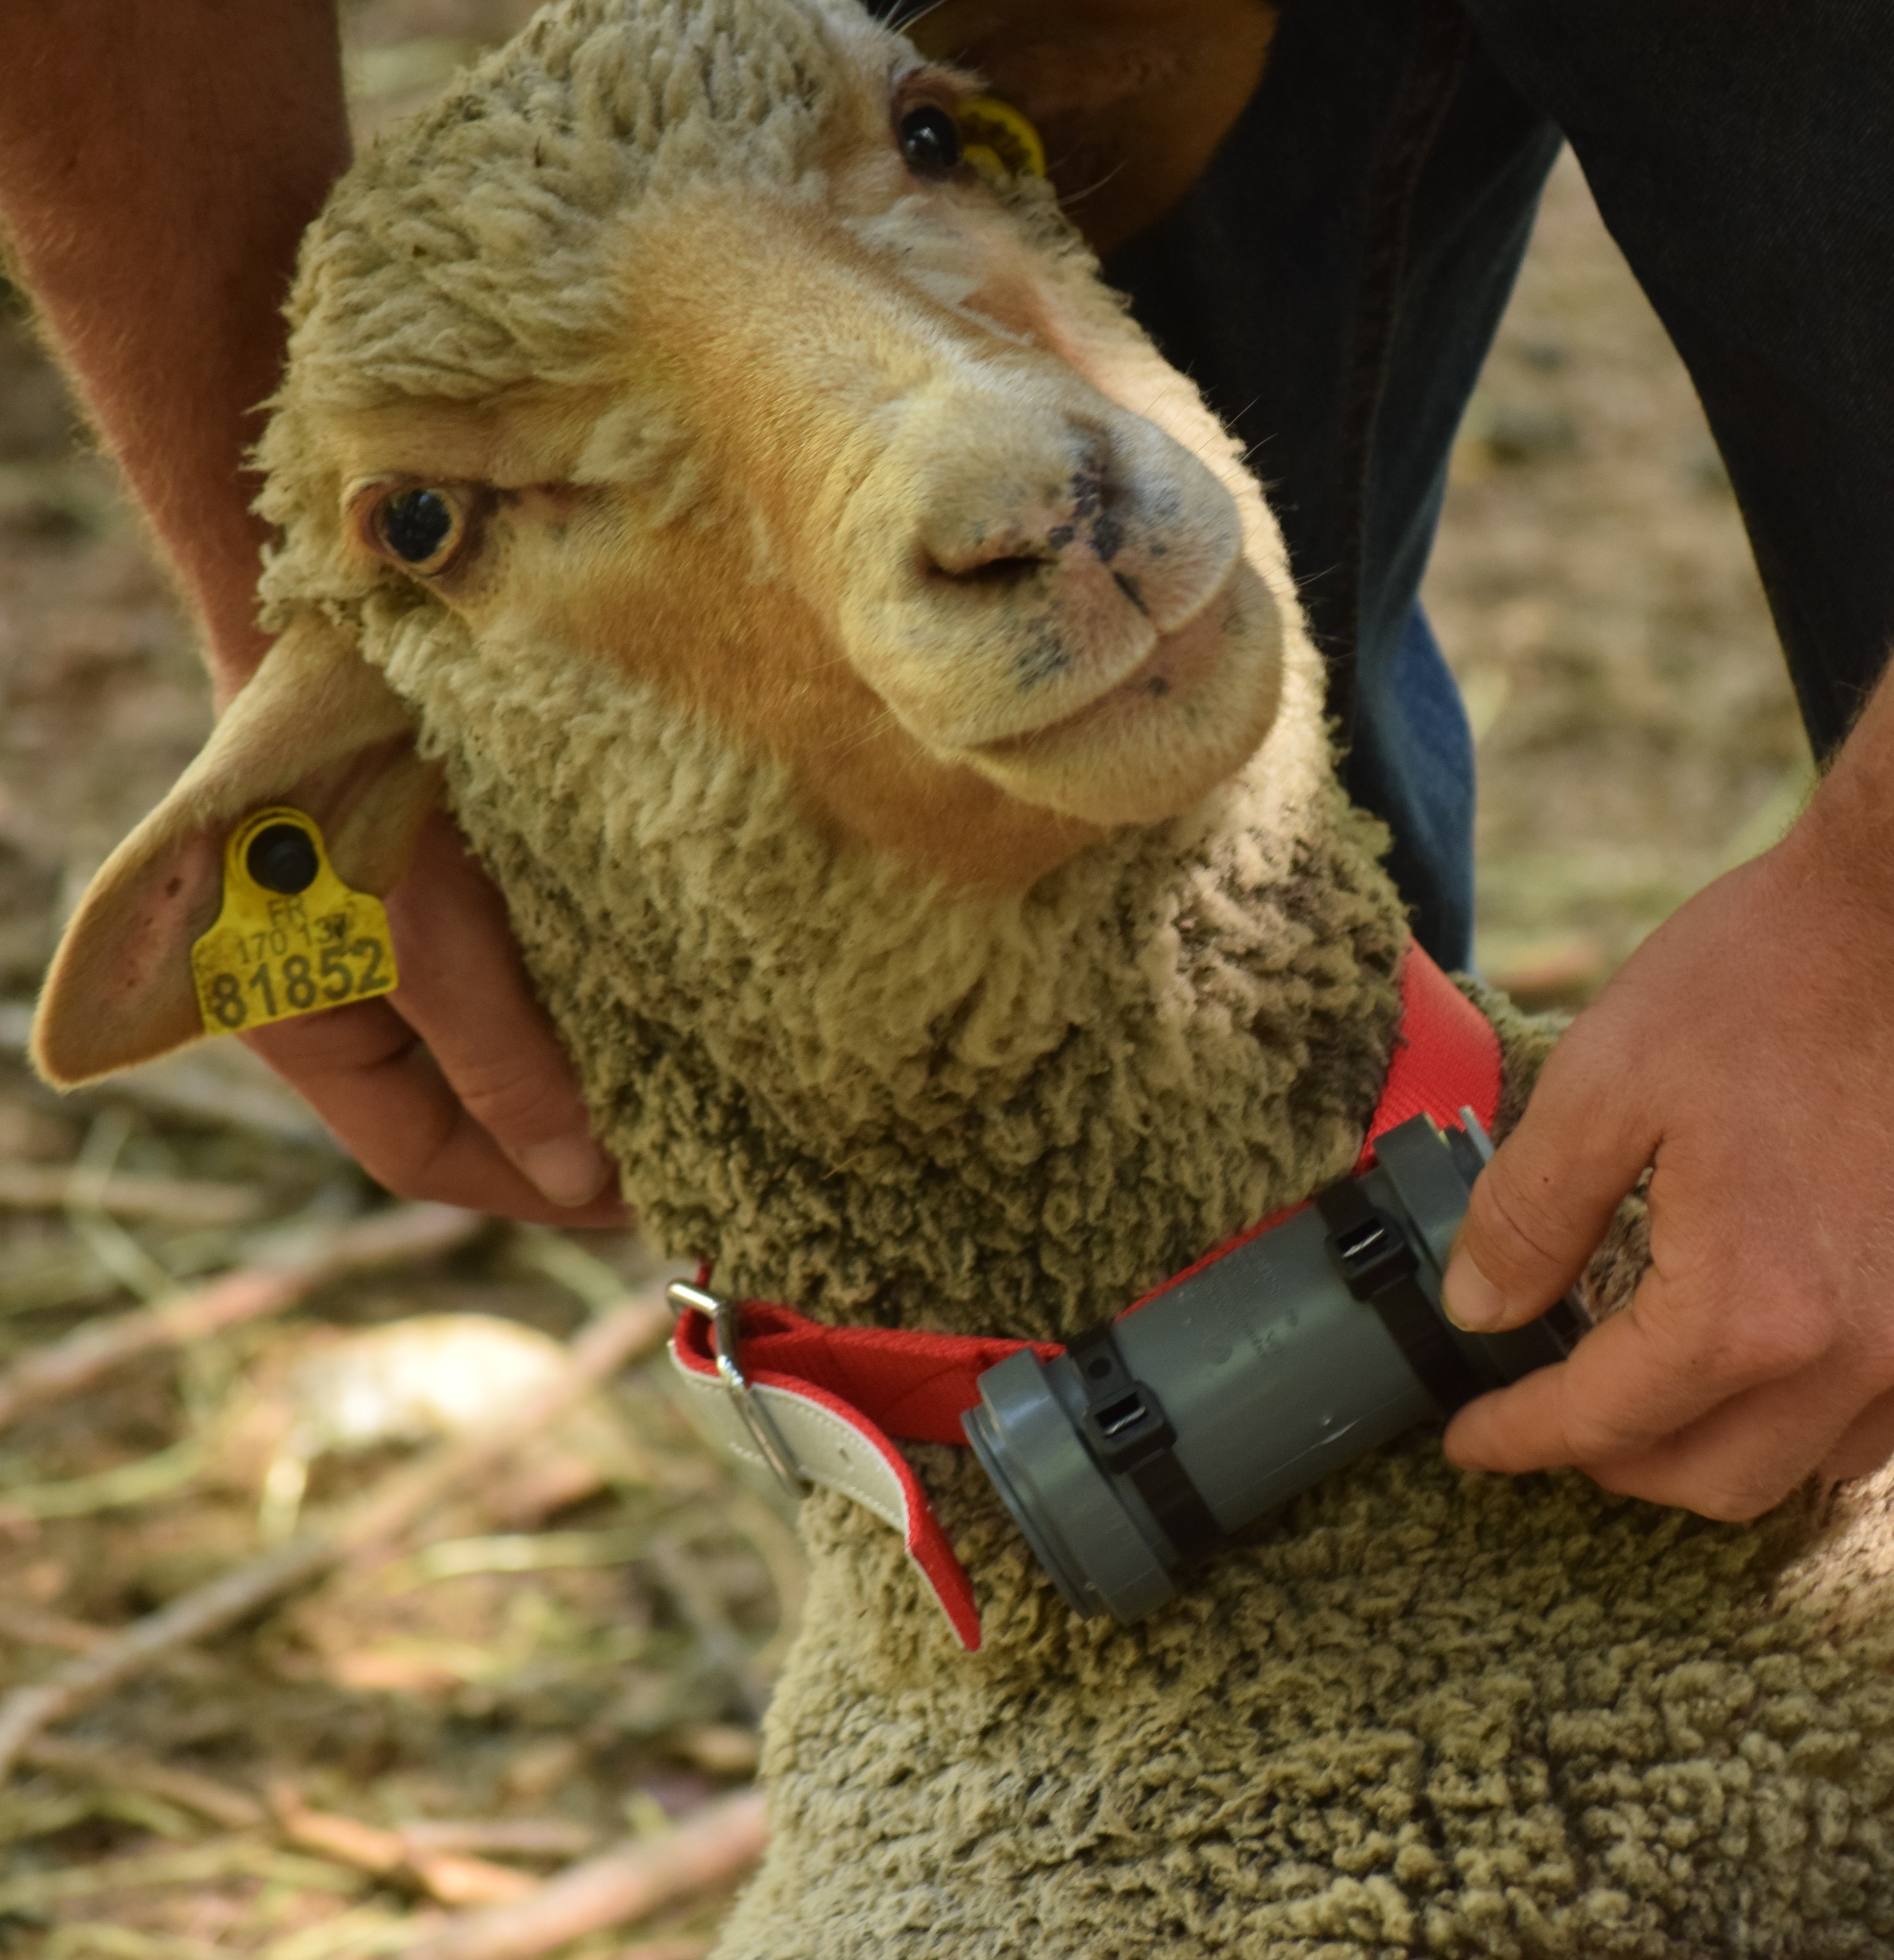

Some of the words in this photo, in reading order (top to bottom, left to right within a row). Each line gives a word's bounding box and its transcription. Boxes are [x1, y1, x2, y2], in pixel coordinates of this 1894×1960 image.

[267, 896, 309, 927] FR
[236, 929, 288, 964] 170
[213, 938, 390, 1028] 81852
